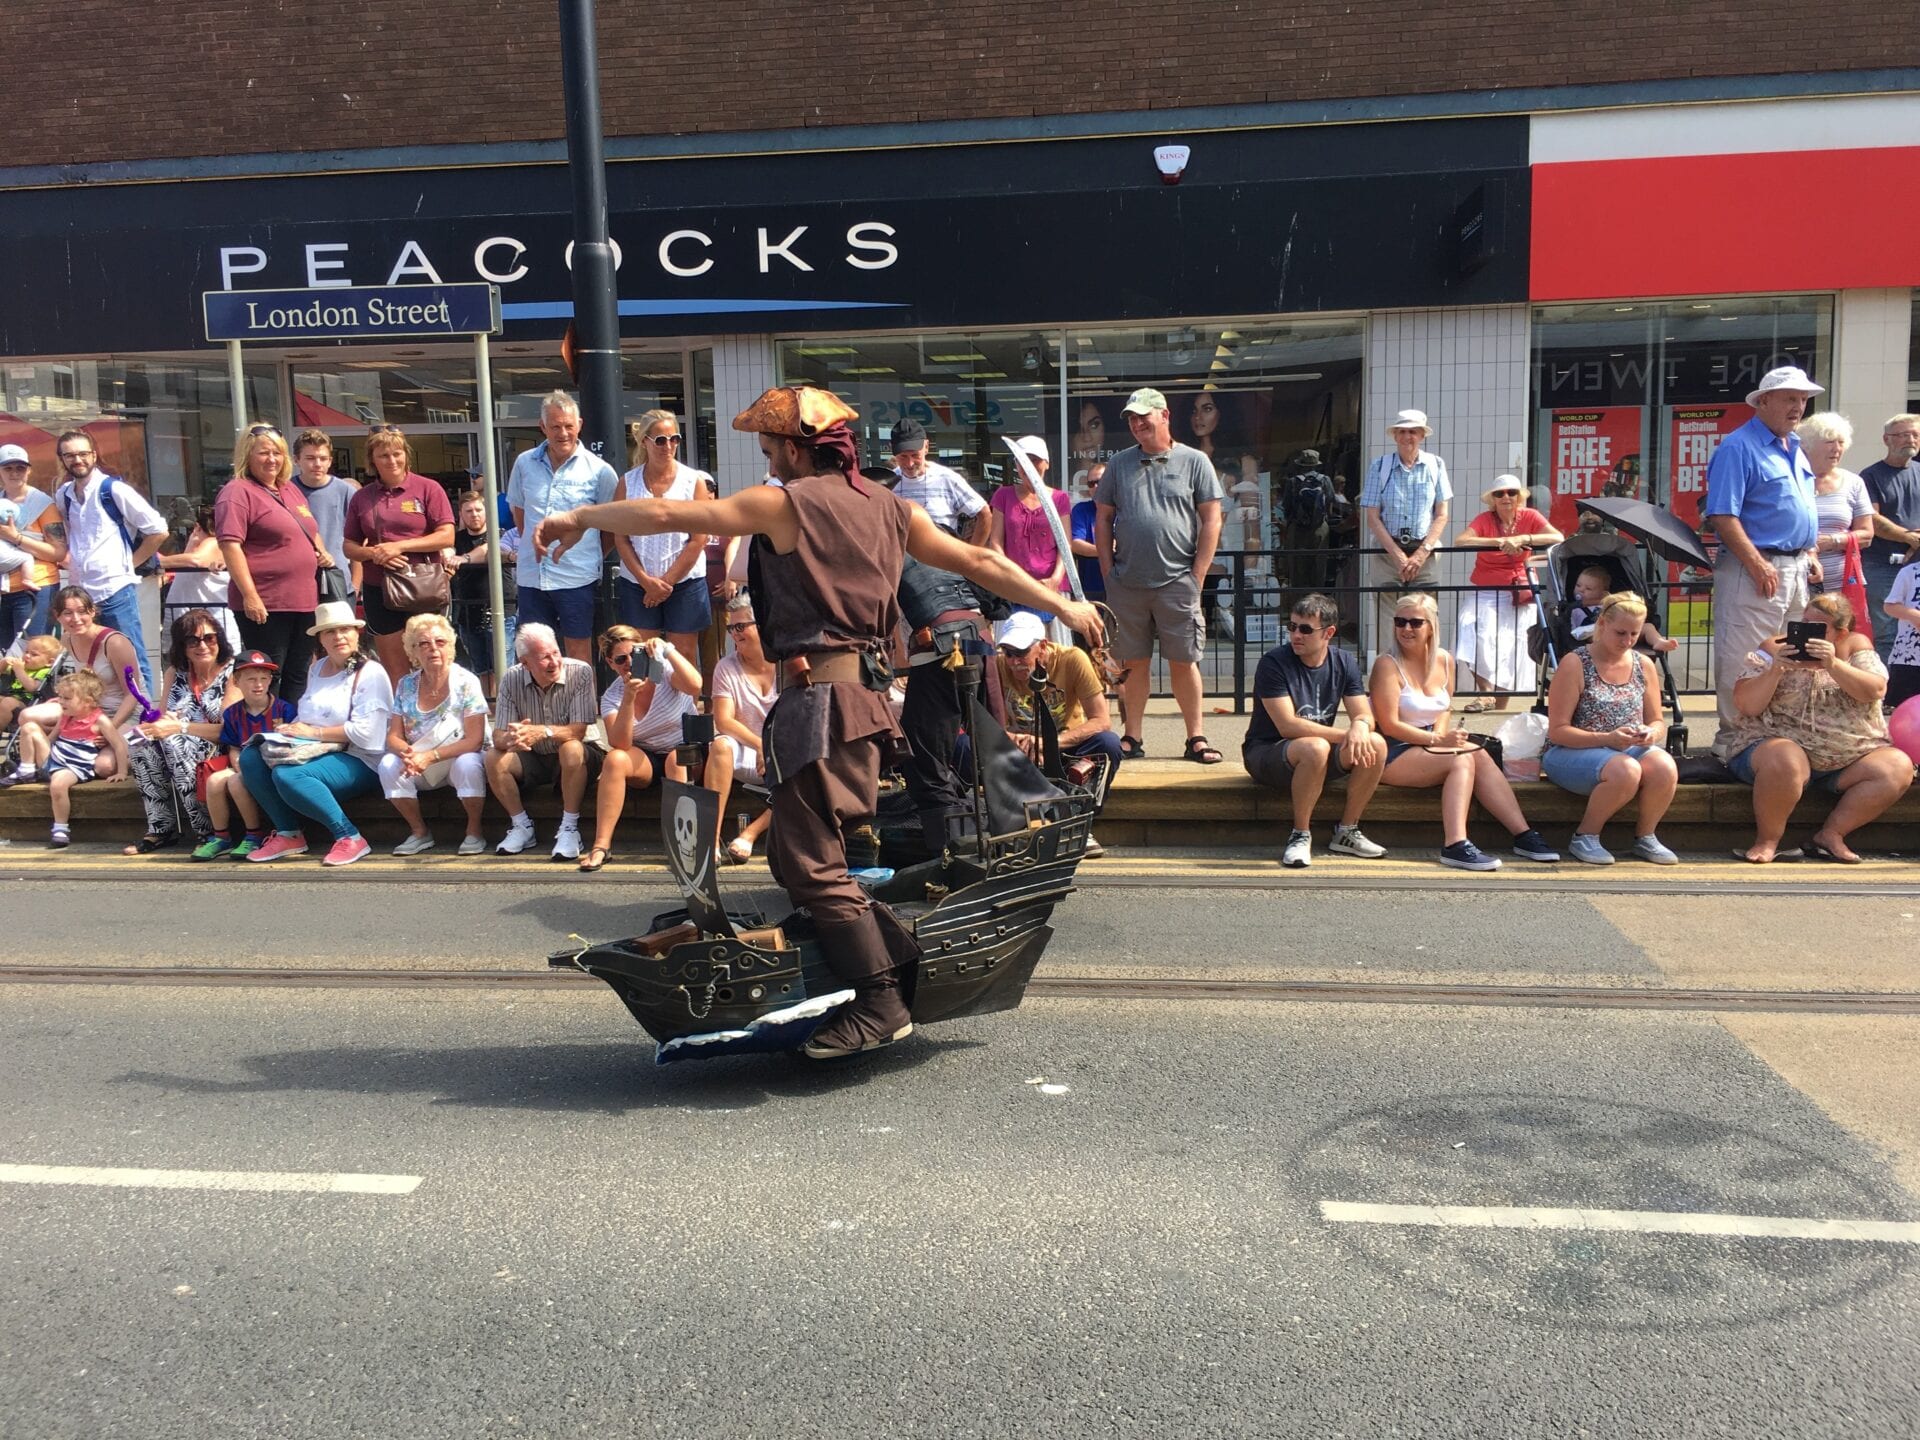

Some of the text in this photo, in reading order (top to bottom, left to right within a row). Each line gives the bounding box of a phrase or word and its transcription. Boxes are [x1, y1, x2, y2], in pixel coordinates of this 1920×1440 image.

[1159, 152, 1185, 160] KINGS
[246, 297, 450, 329] London Street
[1559, 424, 1597, 435] BetStation
[1679, 421, 1718, 432] BetStation
[591, 441, 604, 451] CF
[1558, 436, 1612, 467] FREE
[1678, 433, 1728, 465] FRE
[1678, 465, 1708, 493] BE
